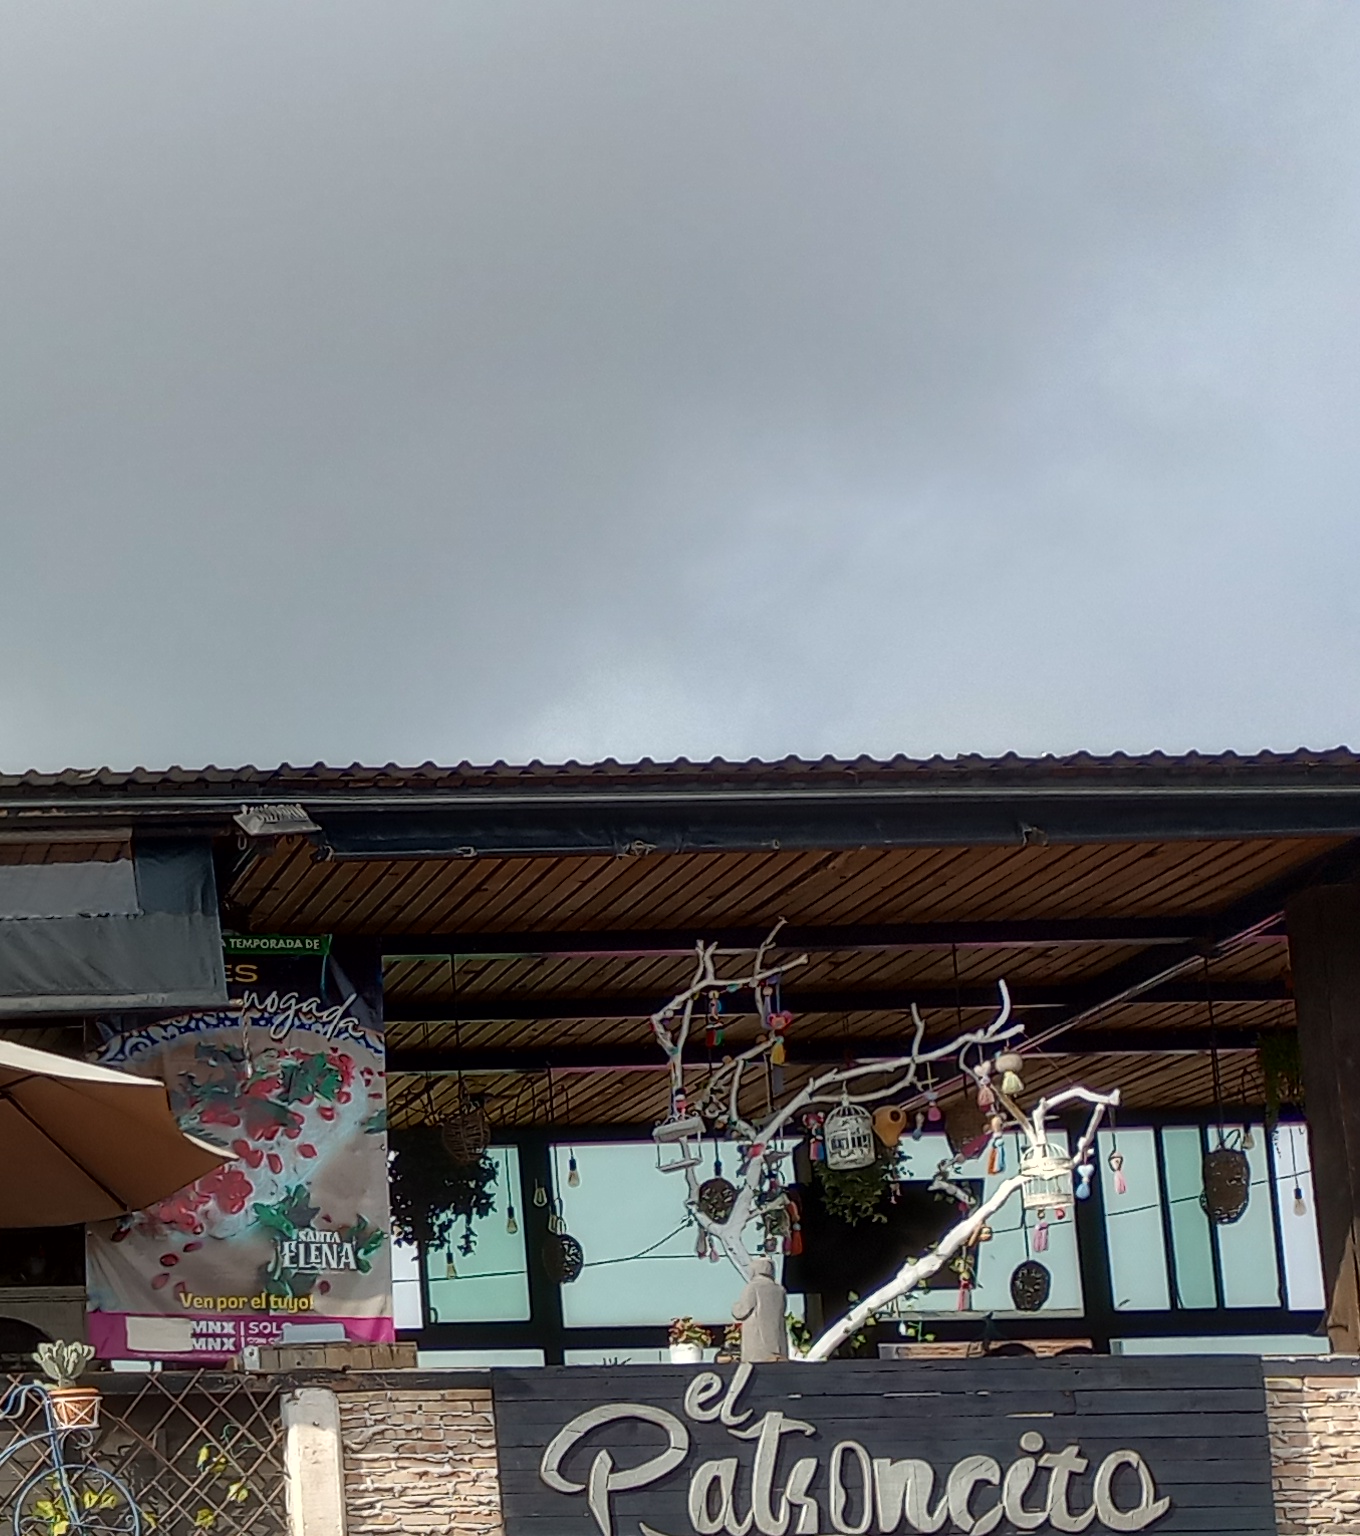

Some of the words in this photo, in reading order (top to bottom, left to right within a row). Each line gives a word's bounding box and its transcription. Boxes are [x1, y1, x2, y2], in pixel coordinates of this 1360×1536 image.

[230, 938, 303, 949] TEMPORADA
[305, 938, 320, 950] DE
[243, 990, 364, 1040] nogada
[298, 1229, 341, 1243] SANTA
[282, 1240, 358, 1270] ELENA
[180, 1293, 213, 1310] Ven
[216, 1296, 248, 1312] por
[251, 1292, 266, 1310] el
[269, 1294, 314, 1314] tuyo!
[191, 1320, 236, 1335] MNX
[248, 1321, 292, 1335] SOL
[191, 1337, 236, 1351] MNX
[684, 1361, 755, 1425] el
